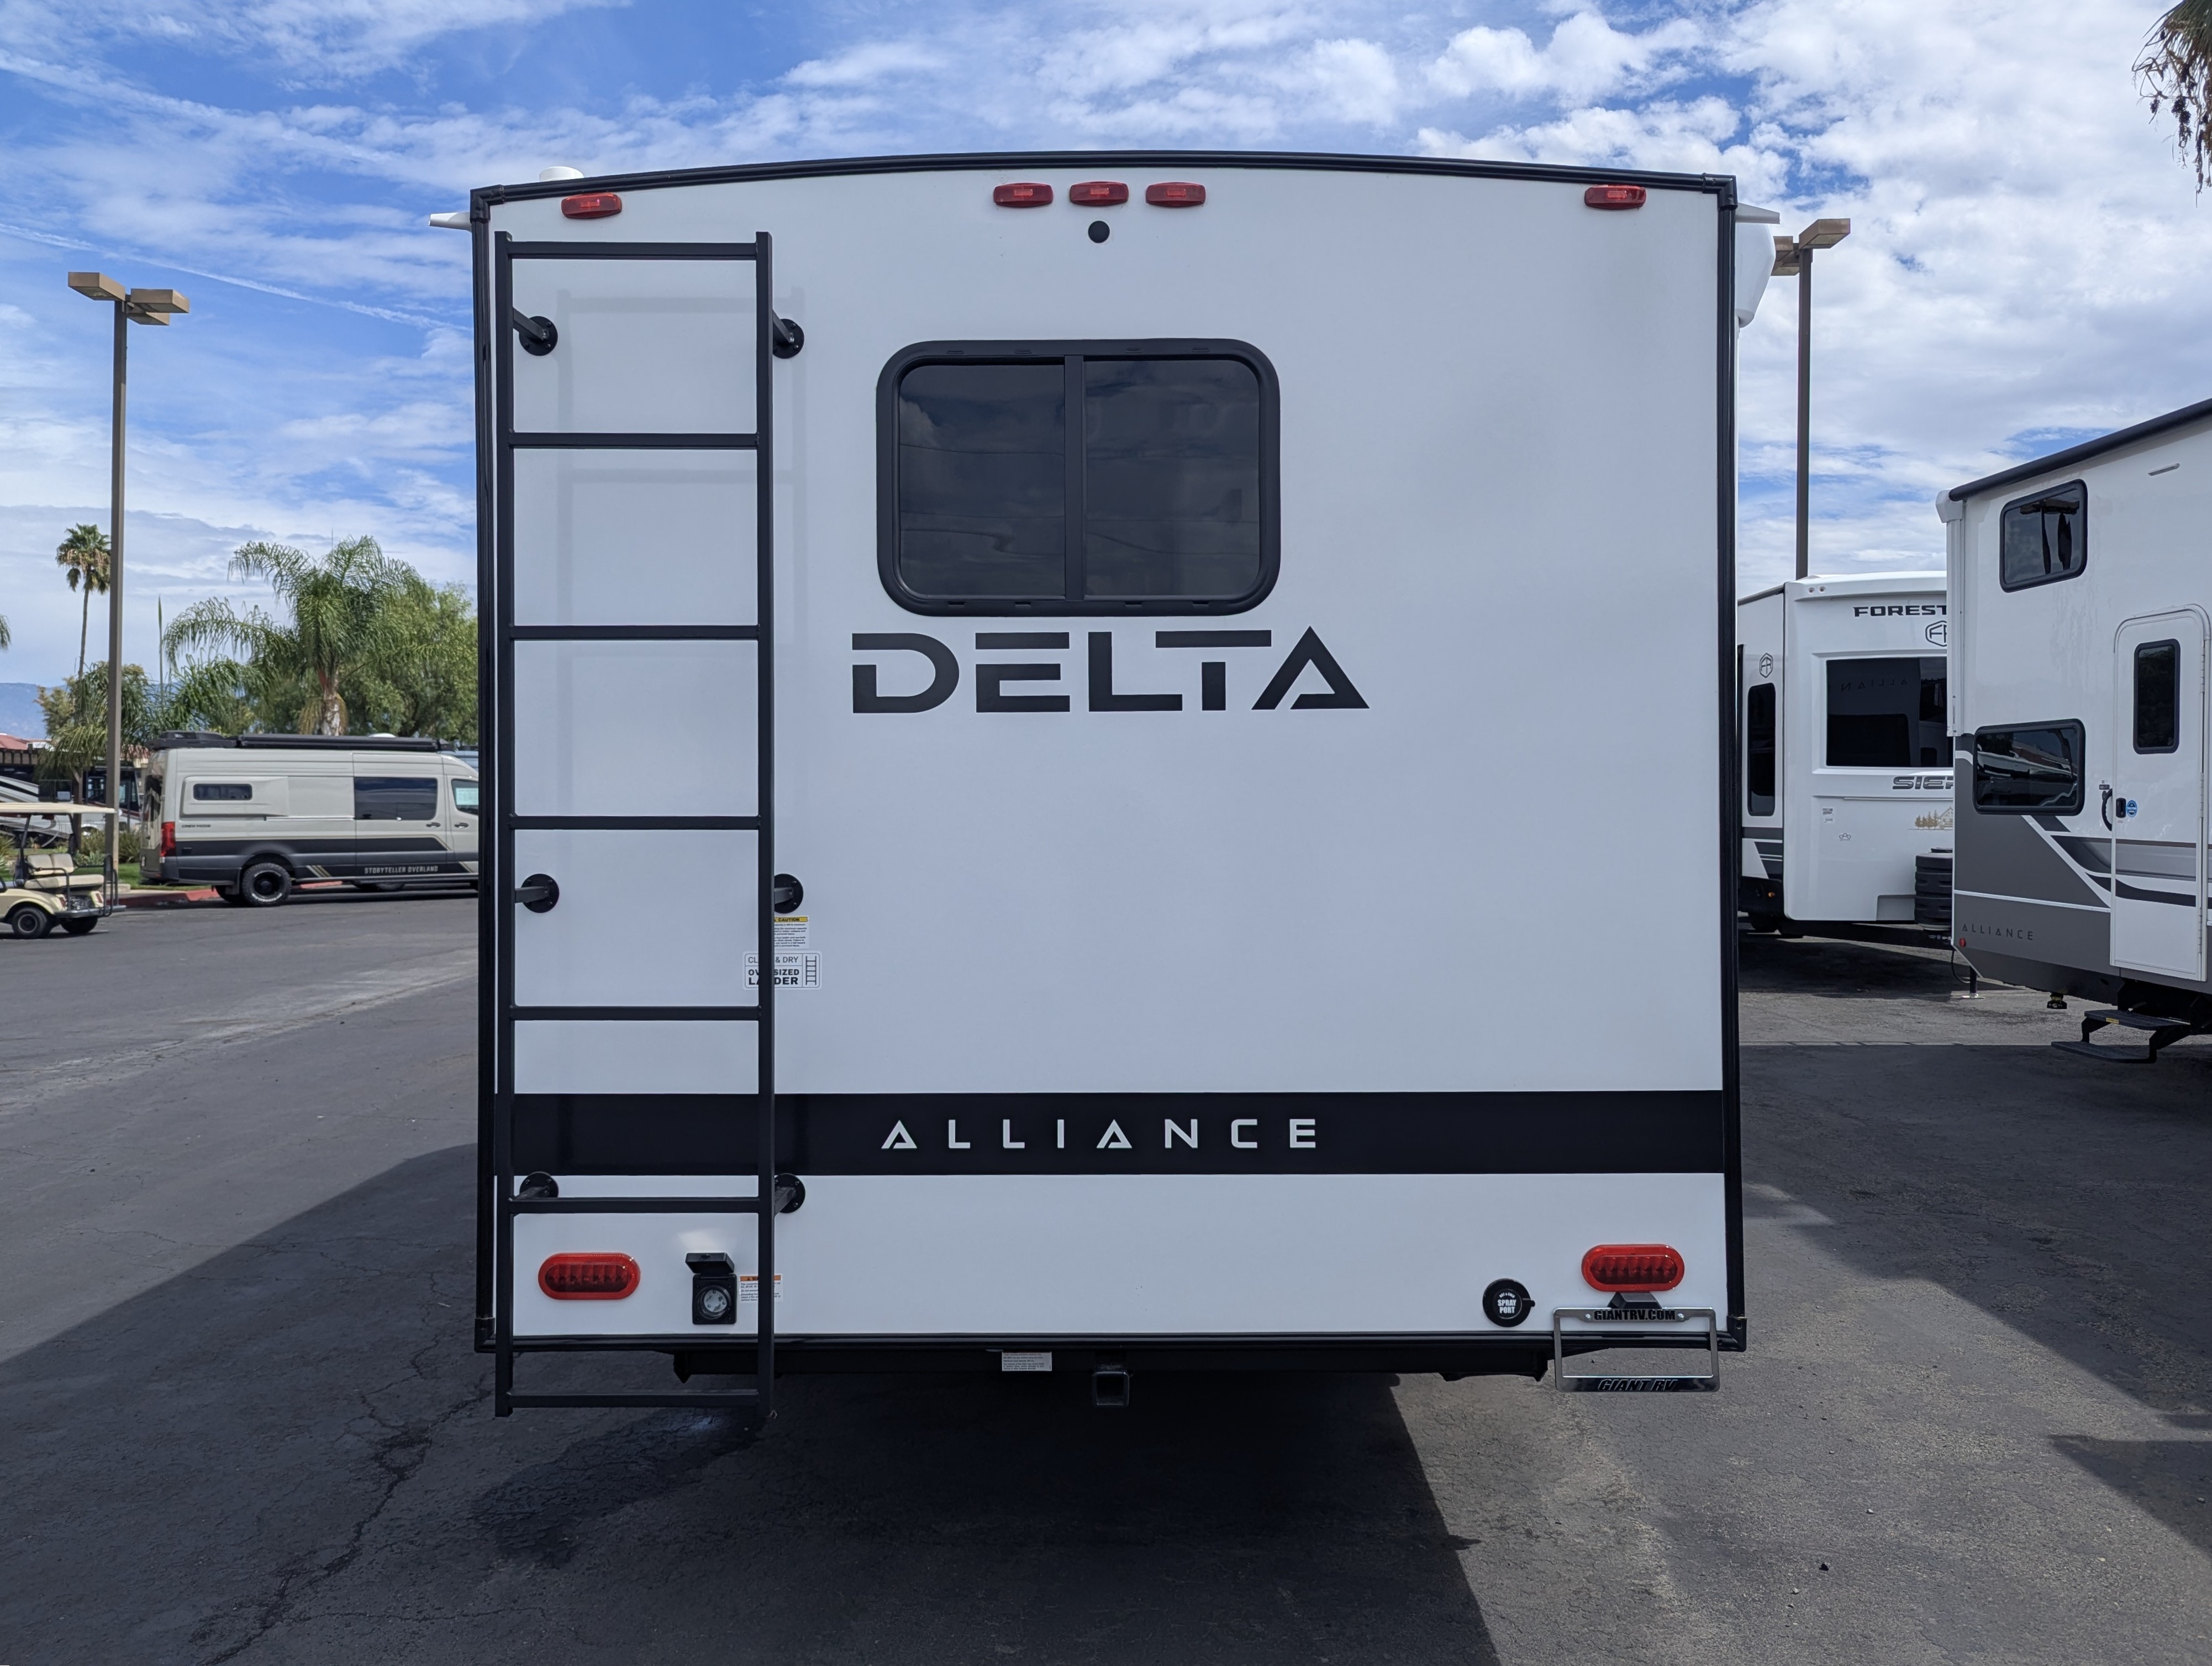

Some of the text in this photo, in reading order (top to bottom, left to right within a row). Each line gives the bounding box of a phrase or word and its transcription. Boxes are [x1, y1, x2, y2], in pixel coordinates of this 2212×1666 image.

[1853, 605, 1946, 617] FOREST
[851, 626, 1370, 714] DELTA
[1962, 923, 2033, 940] ALLIANCE
[749, 977, 799, 985] LDER
[881, 1118, 1316, 1149] ALLIANCE
[1594, 1310, 1676, 1320] GIANTRV.COM
[1598, 1379, 1678, 1391] GIANT RV
